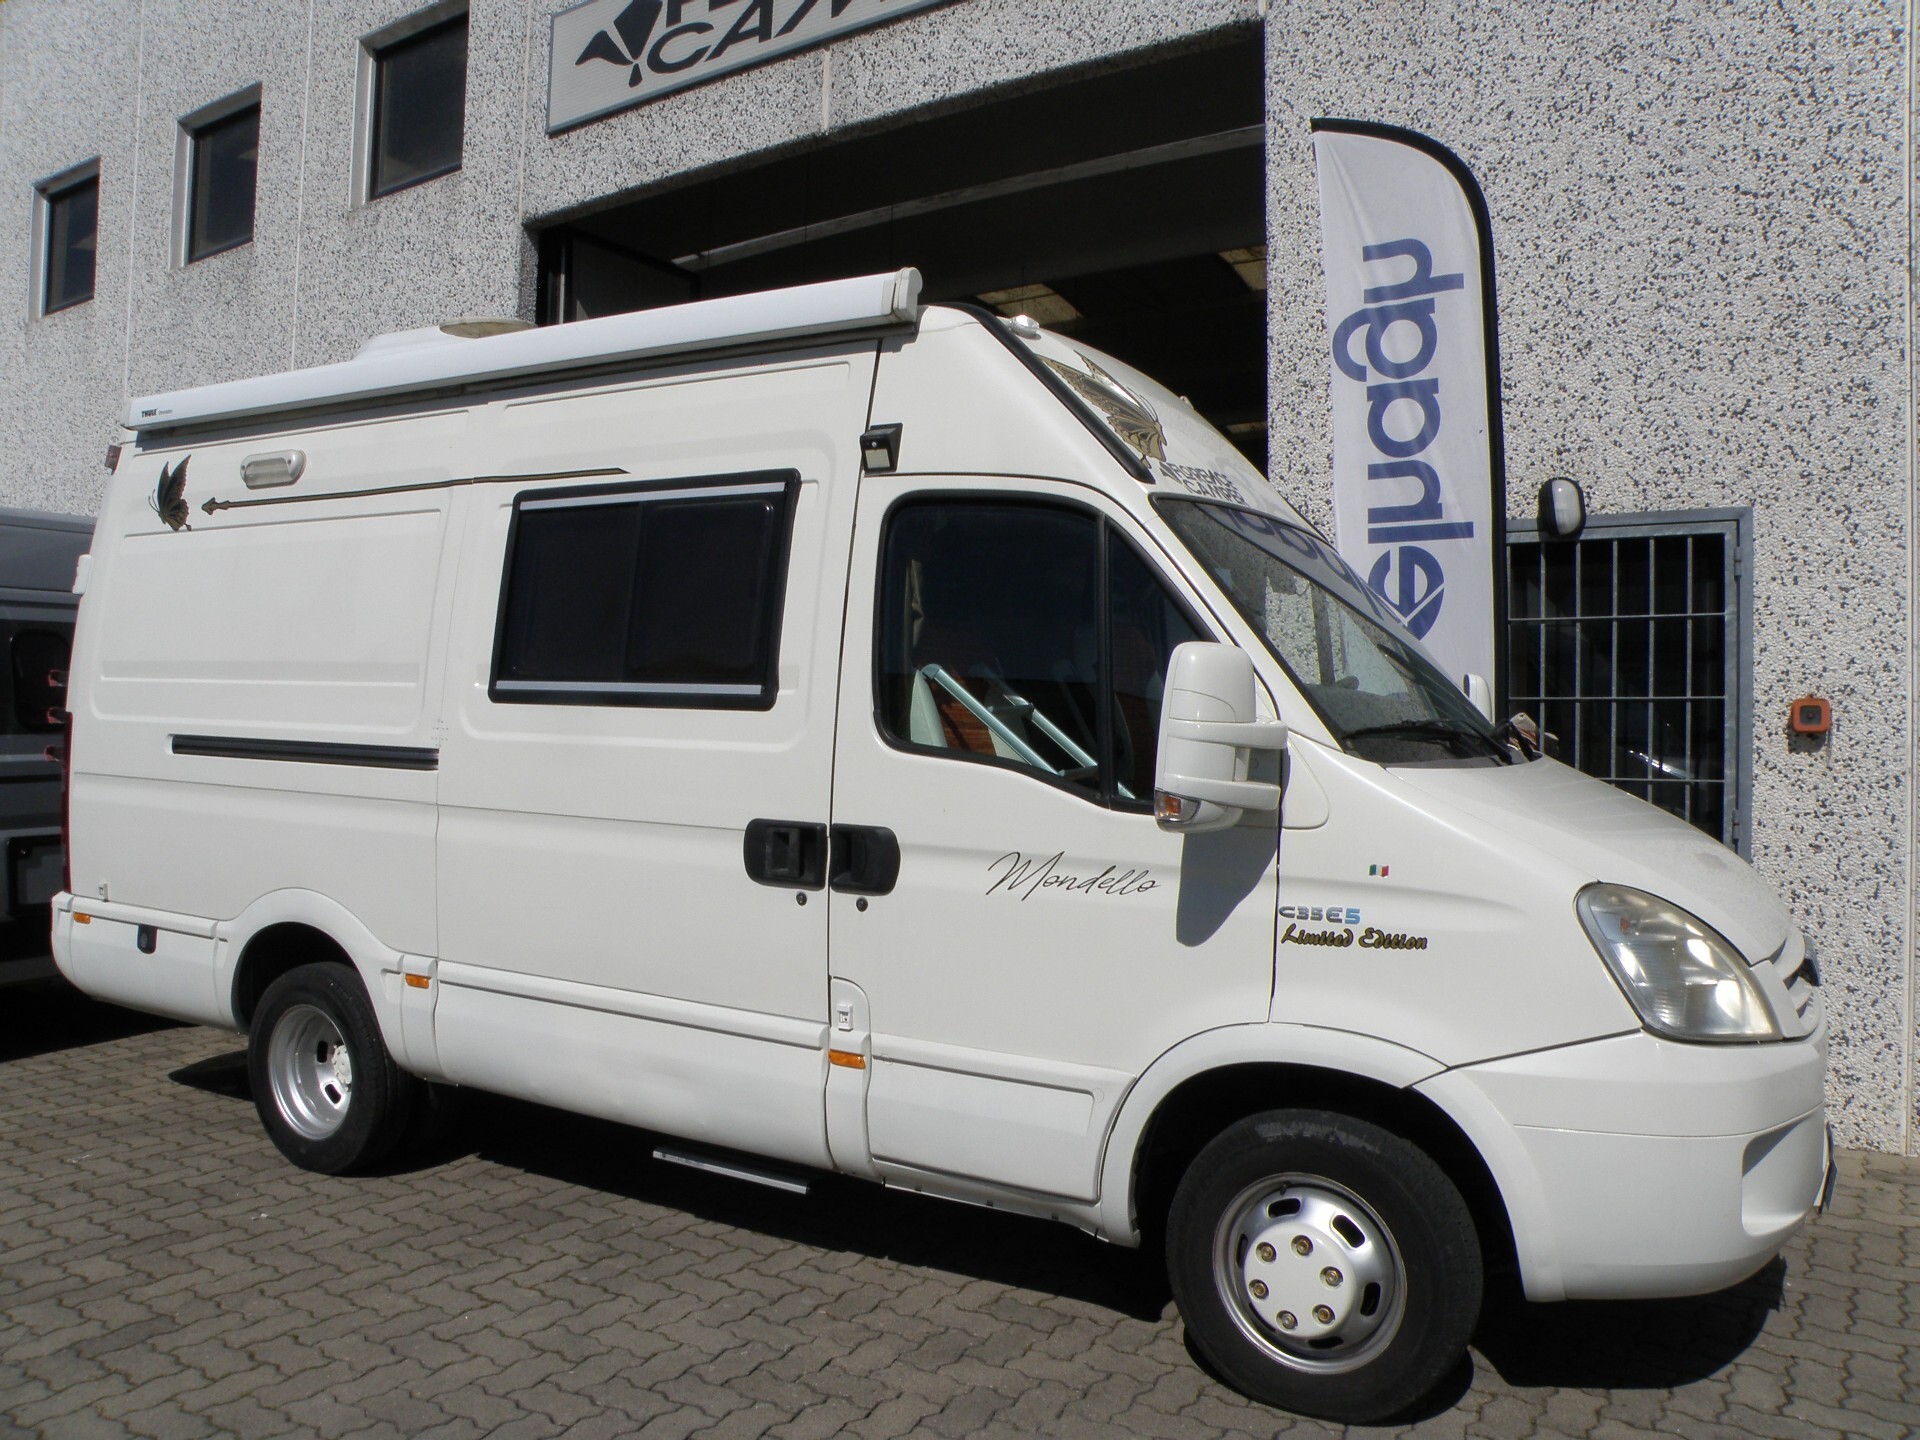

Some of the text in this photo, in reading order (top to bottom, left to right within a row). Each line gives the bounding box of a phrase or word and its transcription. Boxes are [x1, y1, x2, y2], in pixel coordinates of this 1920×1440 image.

[985, 851, 1161, 901] Mondello
[1281, 923, 1428, 950] Limited Edition
